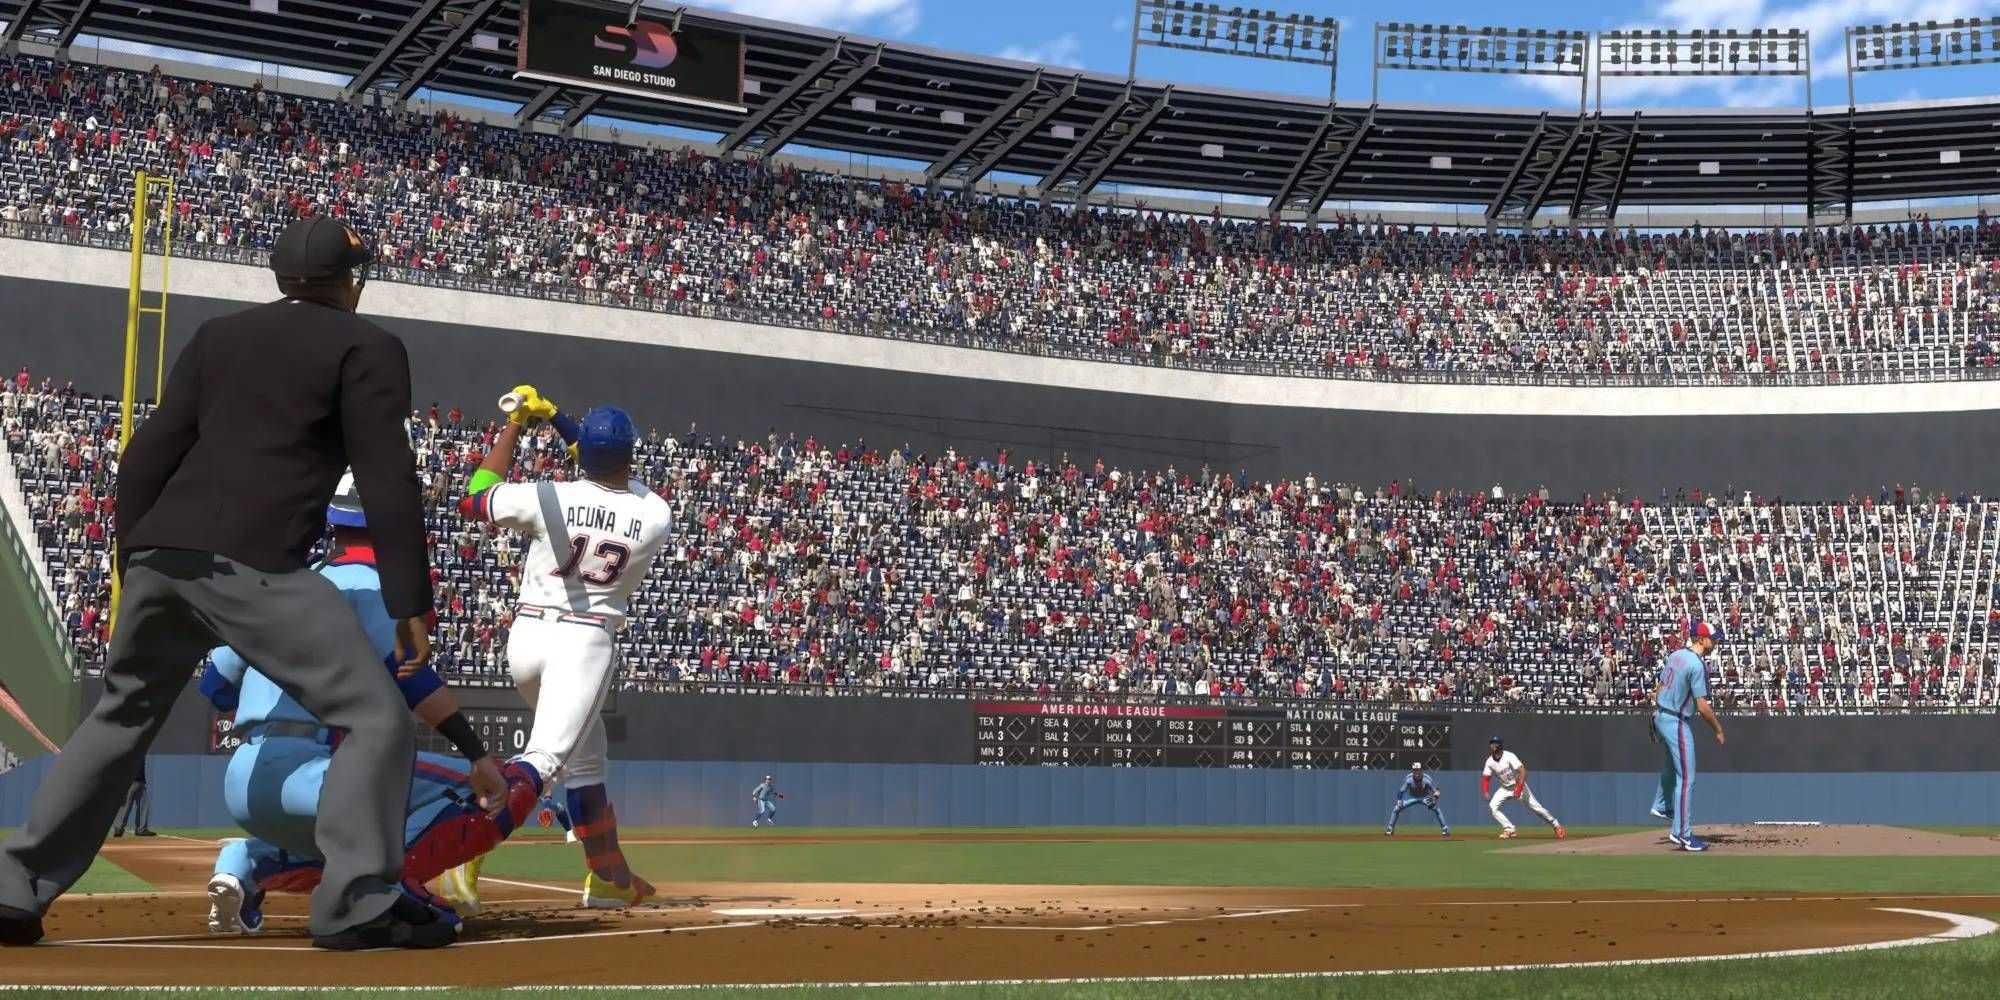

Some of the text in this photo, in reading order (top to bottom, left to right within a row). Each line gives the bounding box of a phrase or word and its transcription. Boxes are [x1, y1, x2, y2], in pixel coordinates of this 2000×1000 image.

[593, 65, 676, 88] SAN DIEGO STUDIO
[567, 505, 643, 543] ACUÑA JR.
[550, 533, 631, 586] 13
[1041, 704, 1165, 716] AMERICAN LEAGUE
[1287, 710, 1398, 722] NATIONAL LEAGUE
[978, 717, 994, 726] TEX
[998, 717, 1004, 726] 7
[1044, 718, 1059, 727] SEA
[1063, 718, 1069, 728] 4
[1107, 720, 1122, 728] OAK
[1126, 720, 1132, 728] 9
[1170, 721, 1184, 729] BOS
[1188, 721, 1193, 730] 2
[1247, 722, 1253, 731] 6
[1290, 724, 1302, 732] STL
[1306, 724, 1311, 732] 4
[1362, 724, 1368, 733] 8
[1401, 726, 1415, 734] CHC
[1418, 726, 1423, 735] 6
[514, 730, 524, 748] 0
[979, 731, 1004, 741] LAA 3
[1045, 732, 1069, 741] BAL 2
[1107, 734, 1132, 743] HOU 4
[1170, 735, 1193, 744] TOR 3
[1247, 736, 1253, 745] 9
[1306, 737, 1311, 746] 5
[1362, 738, 1368, 747] 2
[1418, 739, 1423, 747] 4
[998, 747, 1004, 757] 3
[1043, 748, 1059, 756] NYY
[1063, 748, 1069, 757] 6
[1114, 749, 1122, 758] TB
[1126, 749, 1131, 758] 7
[1247, 751, 1253, 759] 4
[1306, 751, 1311, 760] 4
[1363, 752, 1368, 761] 7
